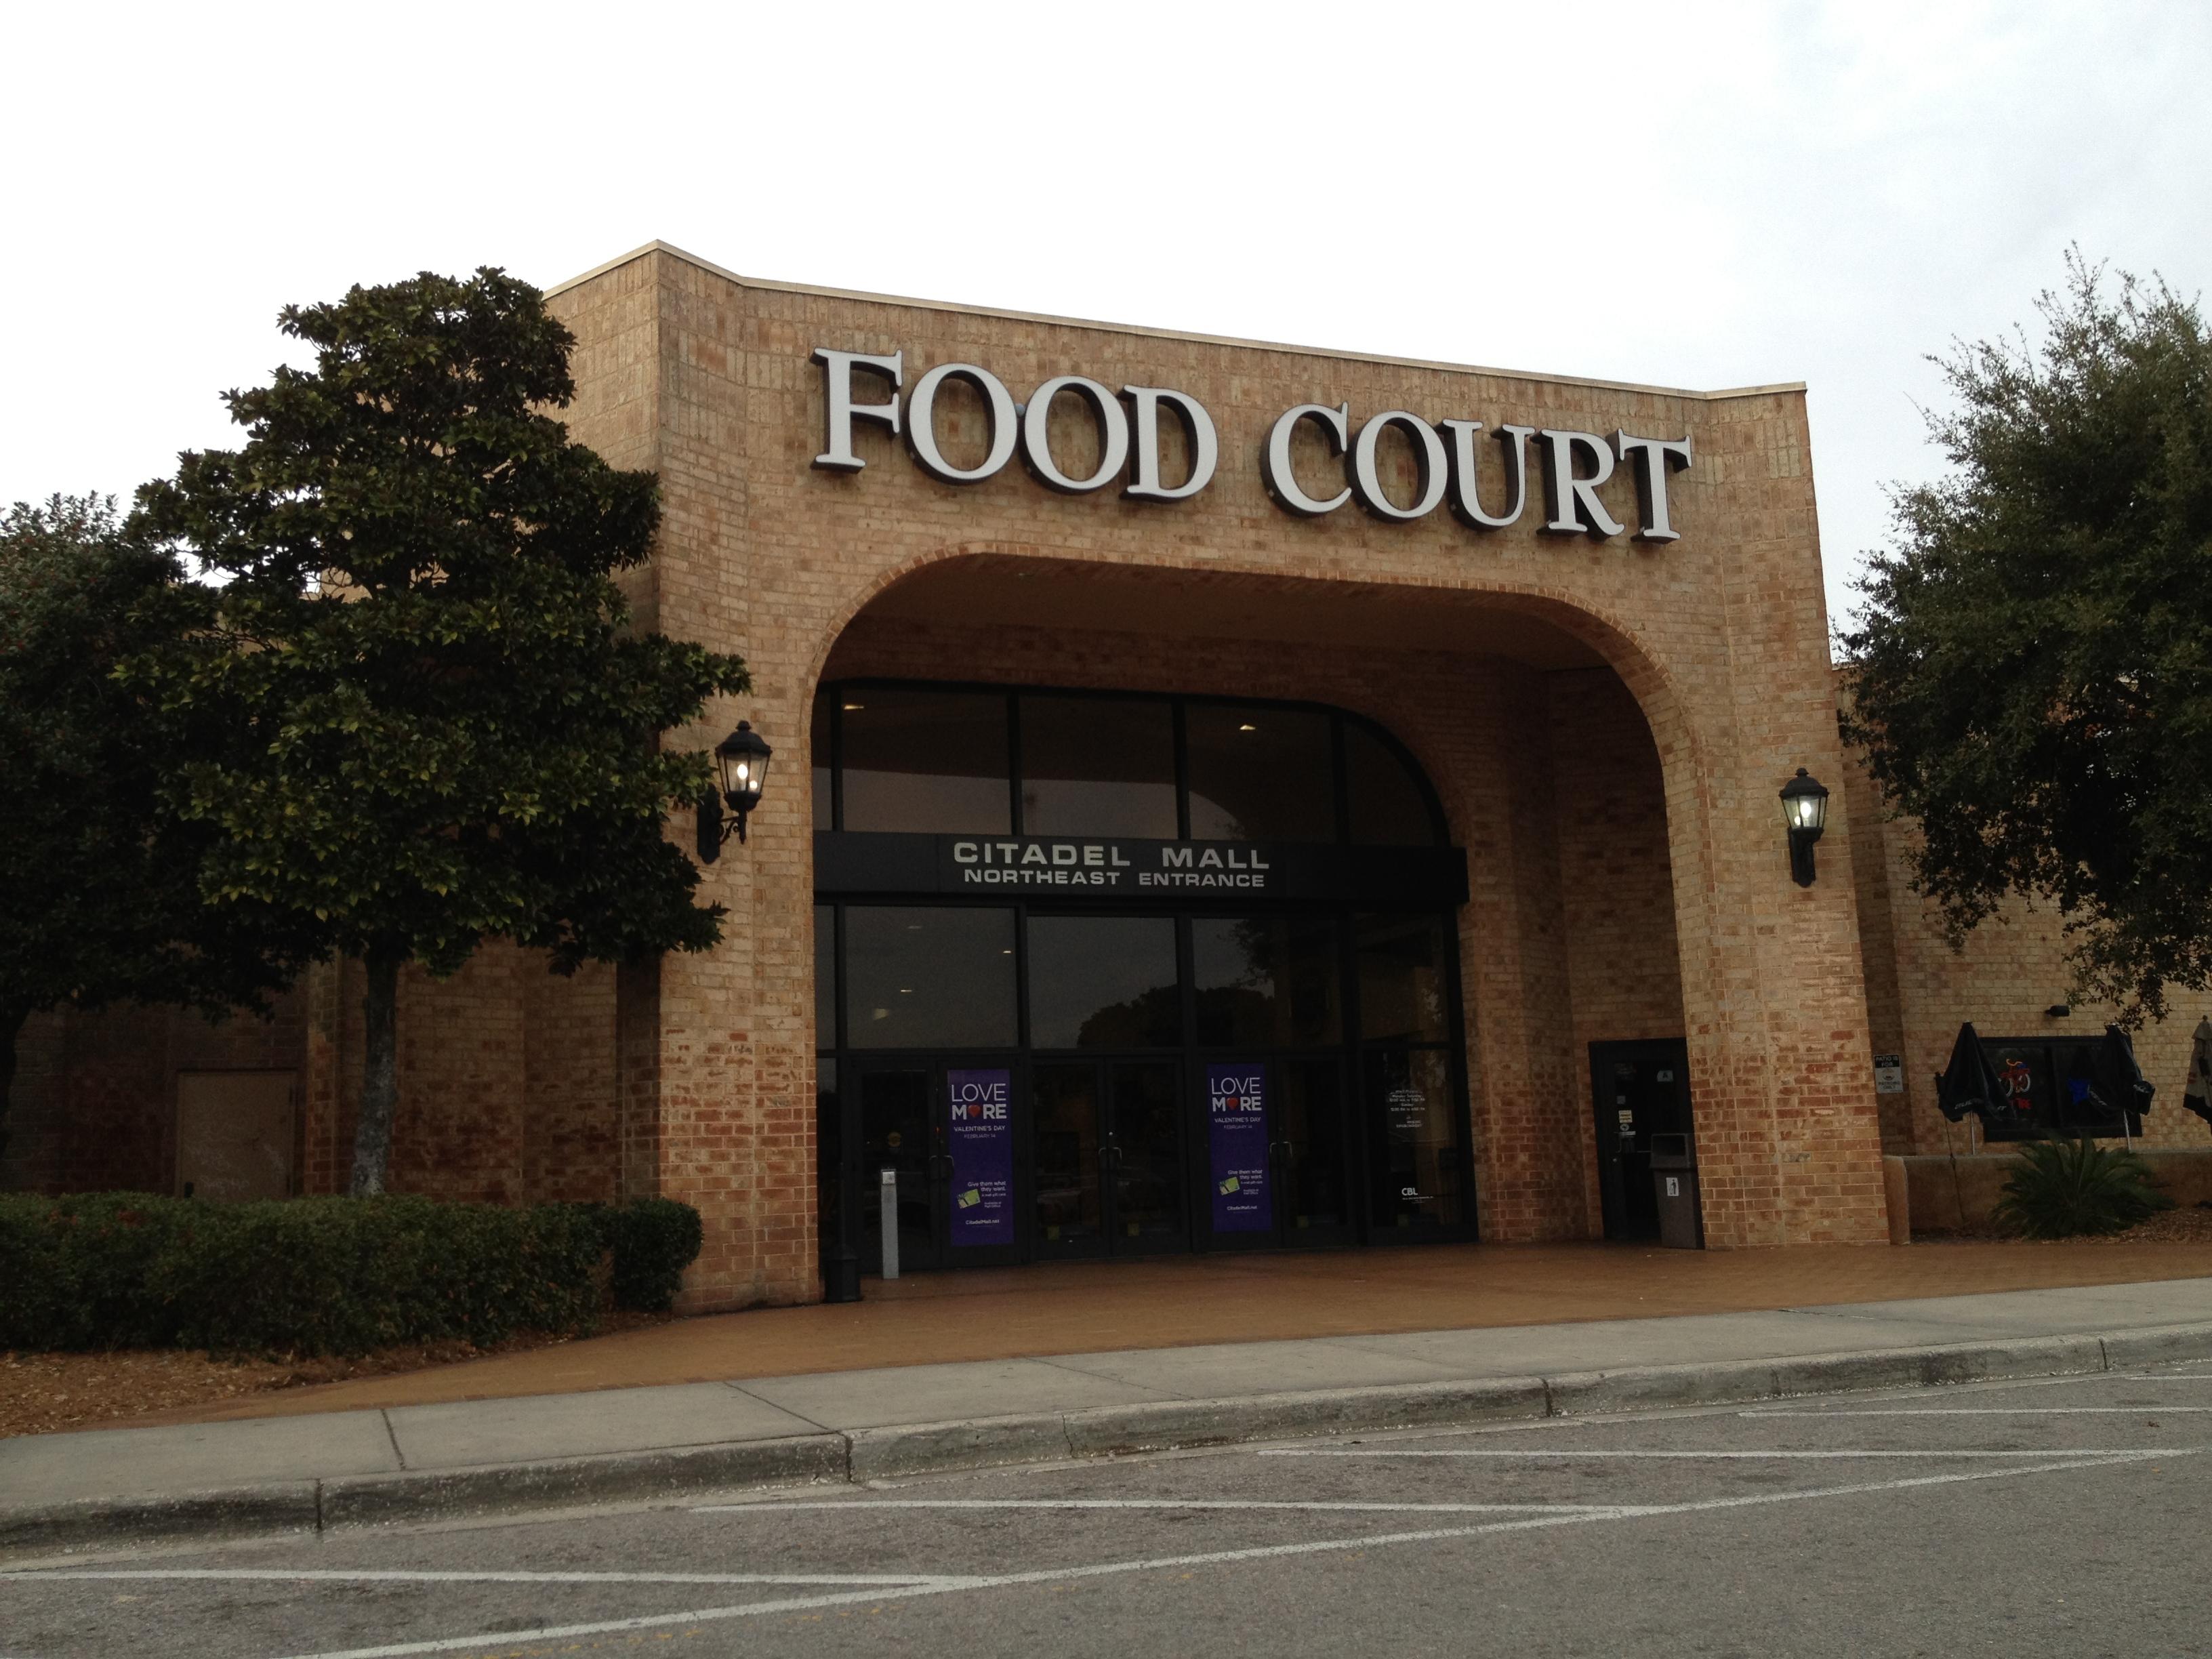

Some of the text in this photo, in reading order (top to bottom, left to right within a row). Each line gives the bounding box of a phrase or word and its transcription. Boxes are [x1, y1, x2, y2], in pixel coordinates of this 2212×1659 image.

[813, 347, 1692, 541] FOOD COURT
[954, 842, 1269, 869] CITADEL MALL
[964, 869, 1265, 887] NORTHEAST ENTRANCE
[951, 1083, 1006, 1102] LOVE
[1211, 1077, 1261, 1094] LOVE
[1401, 1187, 1418, 1196] CBL
